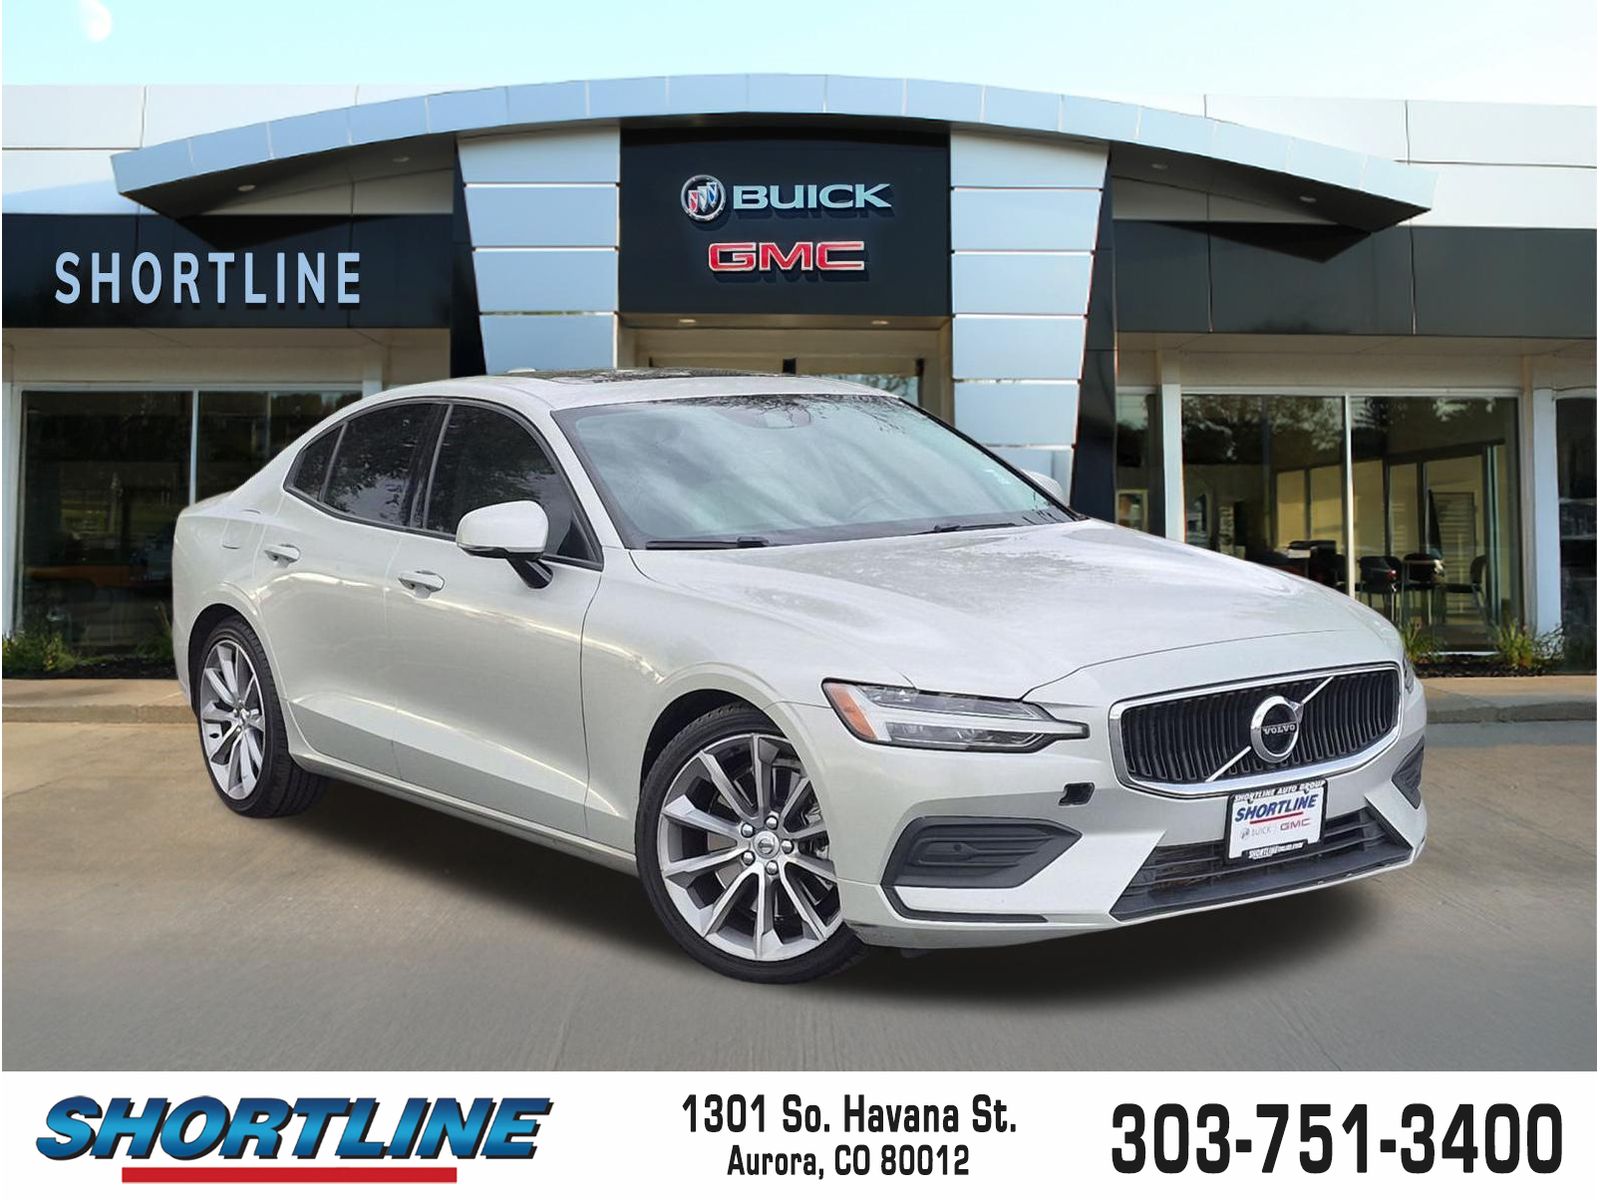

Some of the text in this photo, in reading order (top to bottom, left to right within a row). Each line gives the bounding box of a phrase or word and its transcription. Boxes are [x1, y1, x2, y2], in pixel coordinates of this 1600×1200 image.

[733, 183, 892, 210] BUICK
[708, 241, 865, 272] GMC
[54, 251, 361, 305] SHORTLINE
[1263, 724, 1296, 735] VOLVO
[1234, 780, 1326, 802] SHORTLINE AUTO GROUP
[1235, 794, 1318, 821] SHORTLINE
[1279, 818, 1311, 831] GMC
